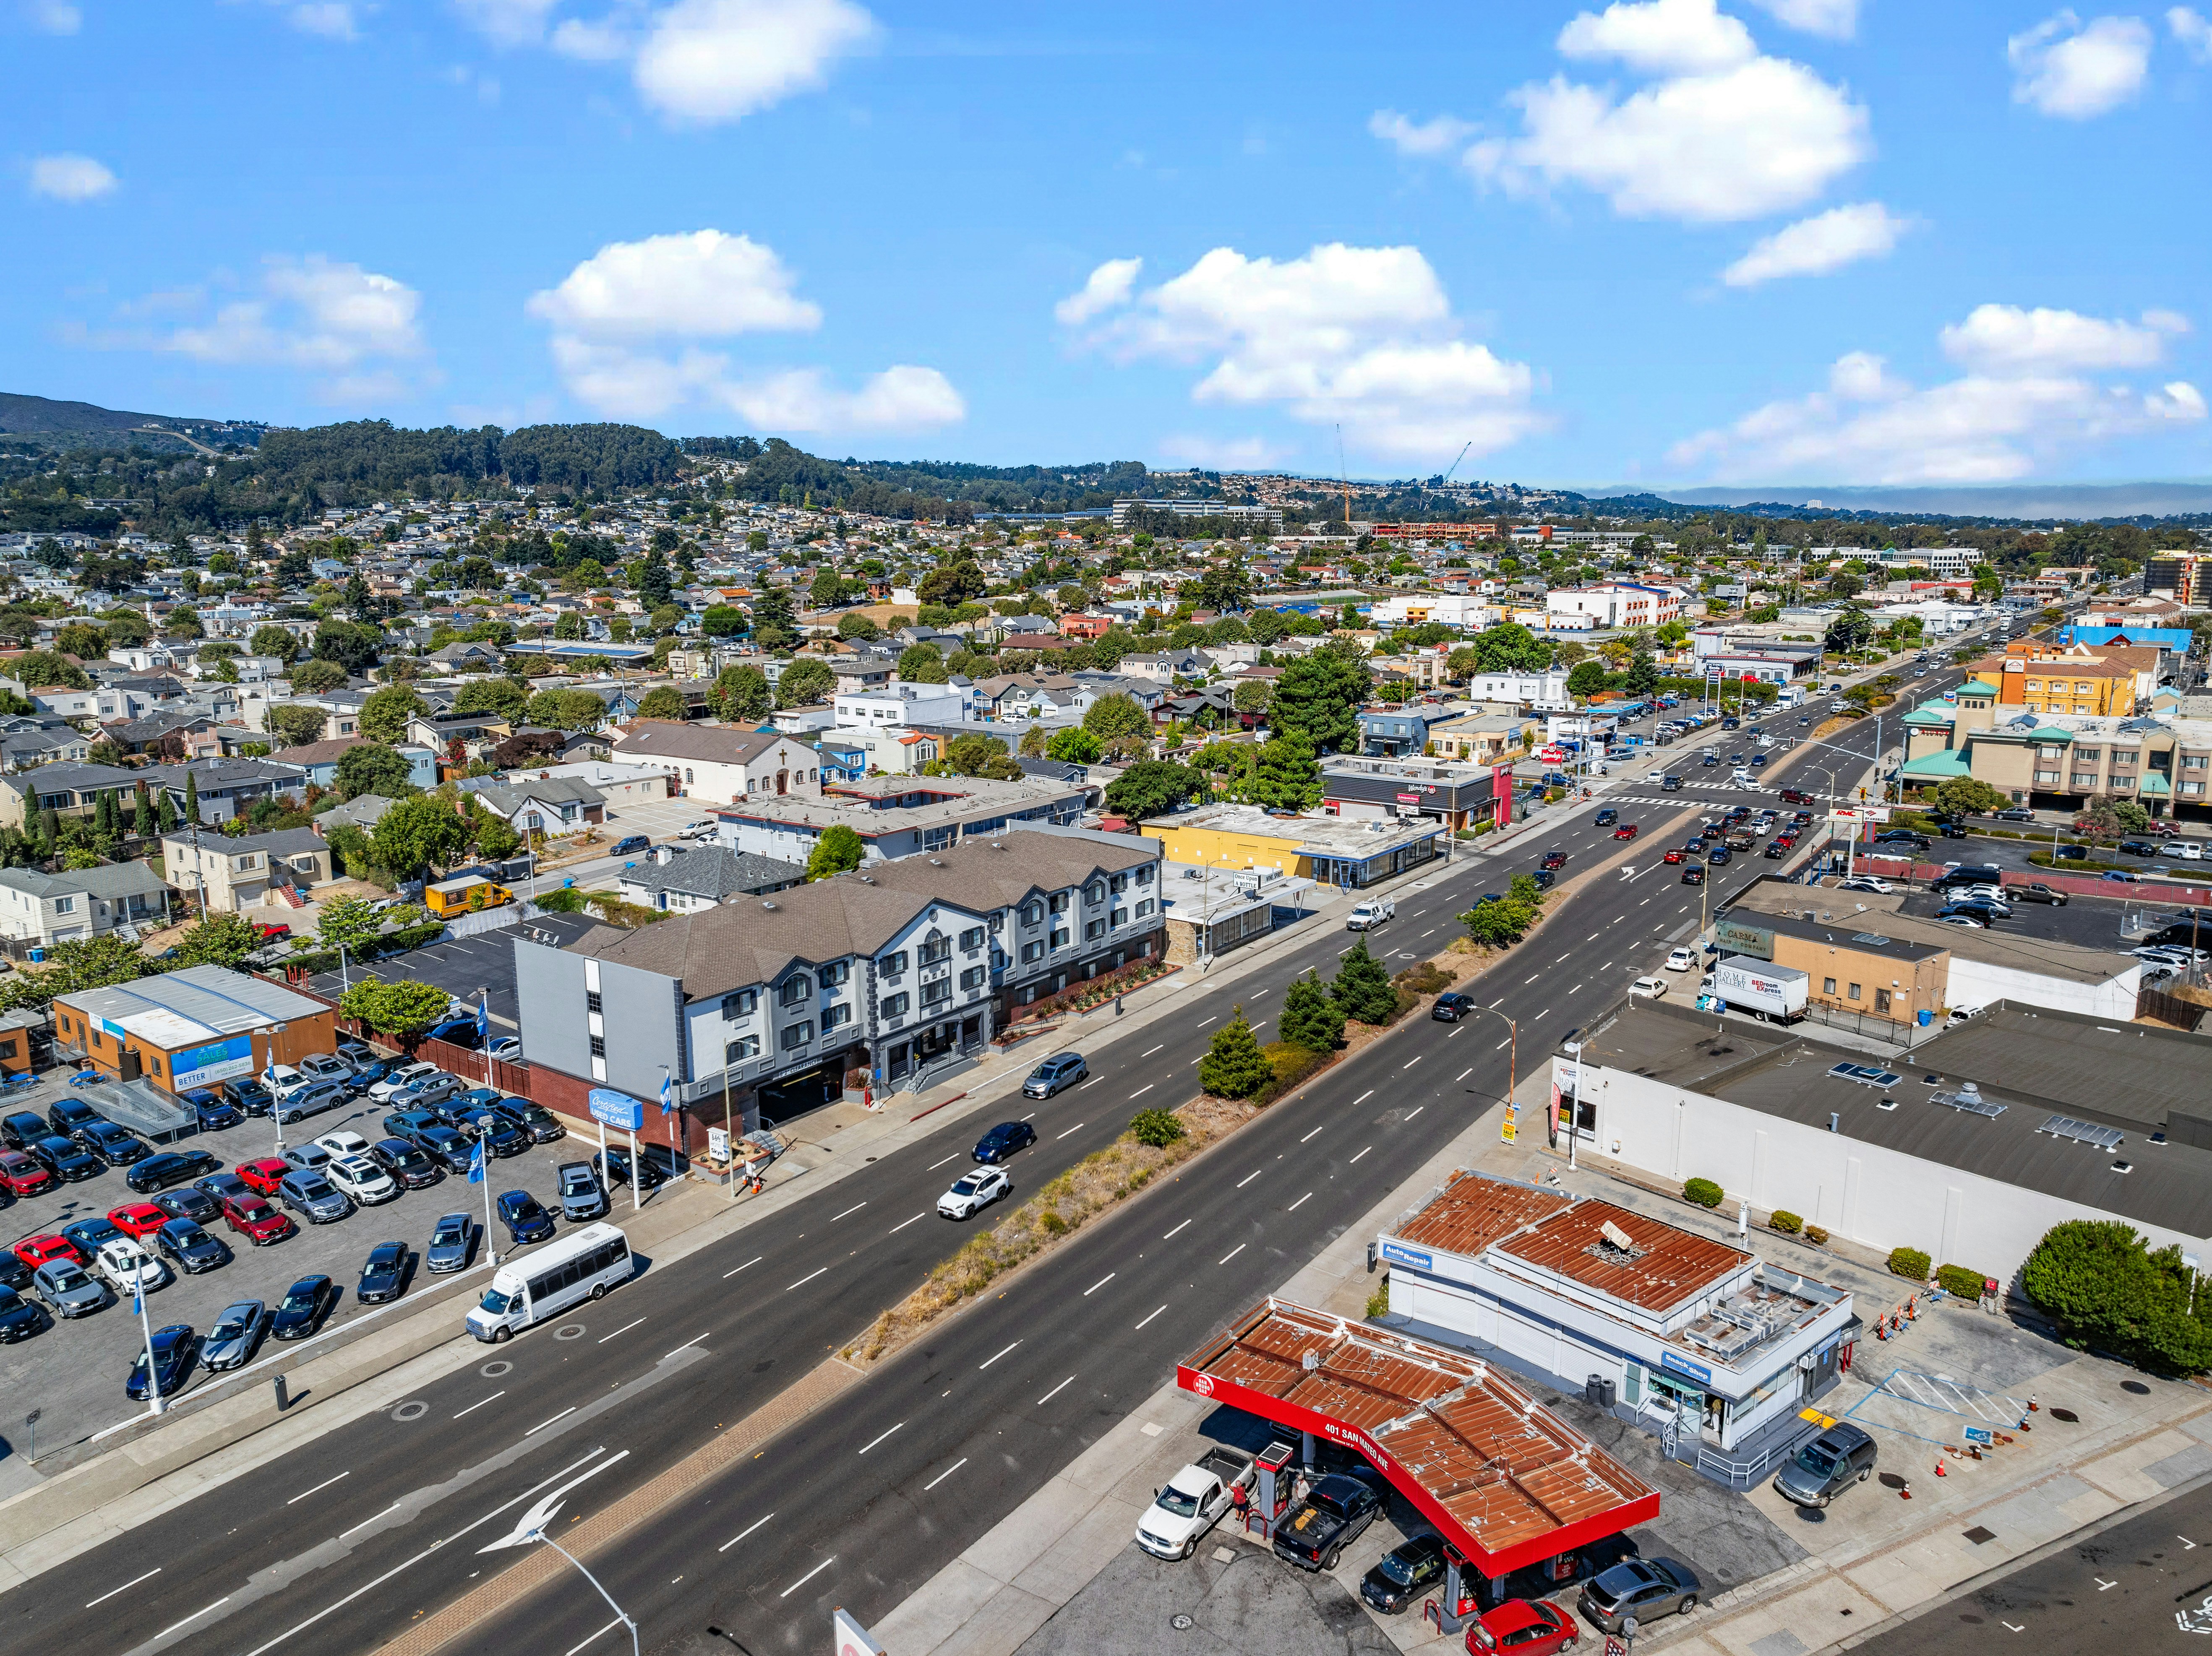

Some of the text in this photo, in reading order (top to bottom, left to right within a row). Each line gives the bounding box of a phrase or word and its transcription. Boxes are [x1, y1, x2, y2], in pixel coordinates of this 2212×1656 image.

[1542, 752, 1561, 760] Wendy's
[1408, 784, 1427, 793] Wendy's
[1274, 870, 1283, 879] SPIRITS
[1728, 930, 1758, 942] CARMA
[1740, 943, 1766, 952] COMPANY
[1716, 968, 1746, 982] HOME
[1716, 975, 1746, 989] GALLERY
[1752, 980, 1778, 988] BEDroom
[196, 1048, 228, 1062] SALES
[197, 1055, 228, 1067] DEPARTMENT
[228, 1061, 251, 1070] 262-5836
[790, 1058, 818, 1073] CLEARANCE
[178, 1073, 206, 1086] BETTER
[592, 1096, 629, 1114] Certified
[591, 1108, 631, 1128] USED CARS
[1578, 1129, 1595, 1138] ERTAINMENT
[574, 1237, 611, 1258] CLASSIC SHUTTLE
[1385, 1246, 1429, 1265] Auto Repair
[1665, 1354, 1708, 1380] Snack Shop
[1650, 1370, 1663, 1380] ATM
[1196, 1382, 1210, 1391] BRUNO
[1331, 1437, 1346, 1445] Clearance
[1325, 1424, 1388, 1471] 401 SAN MATEO AVE
